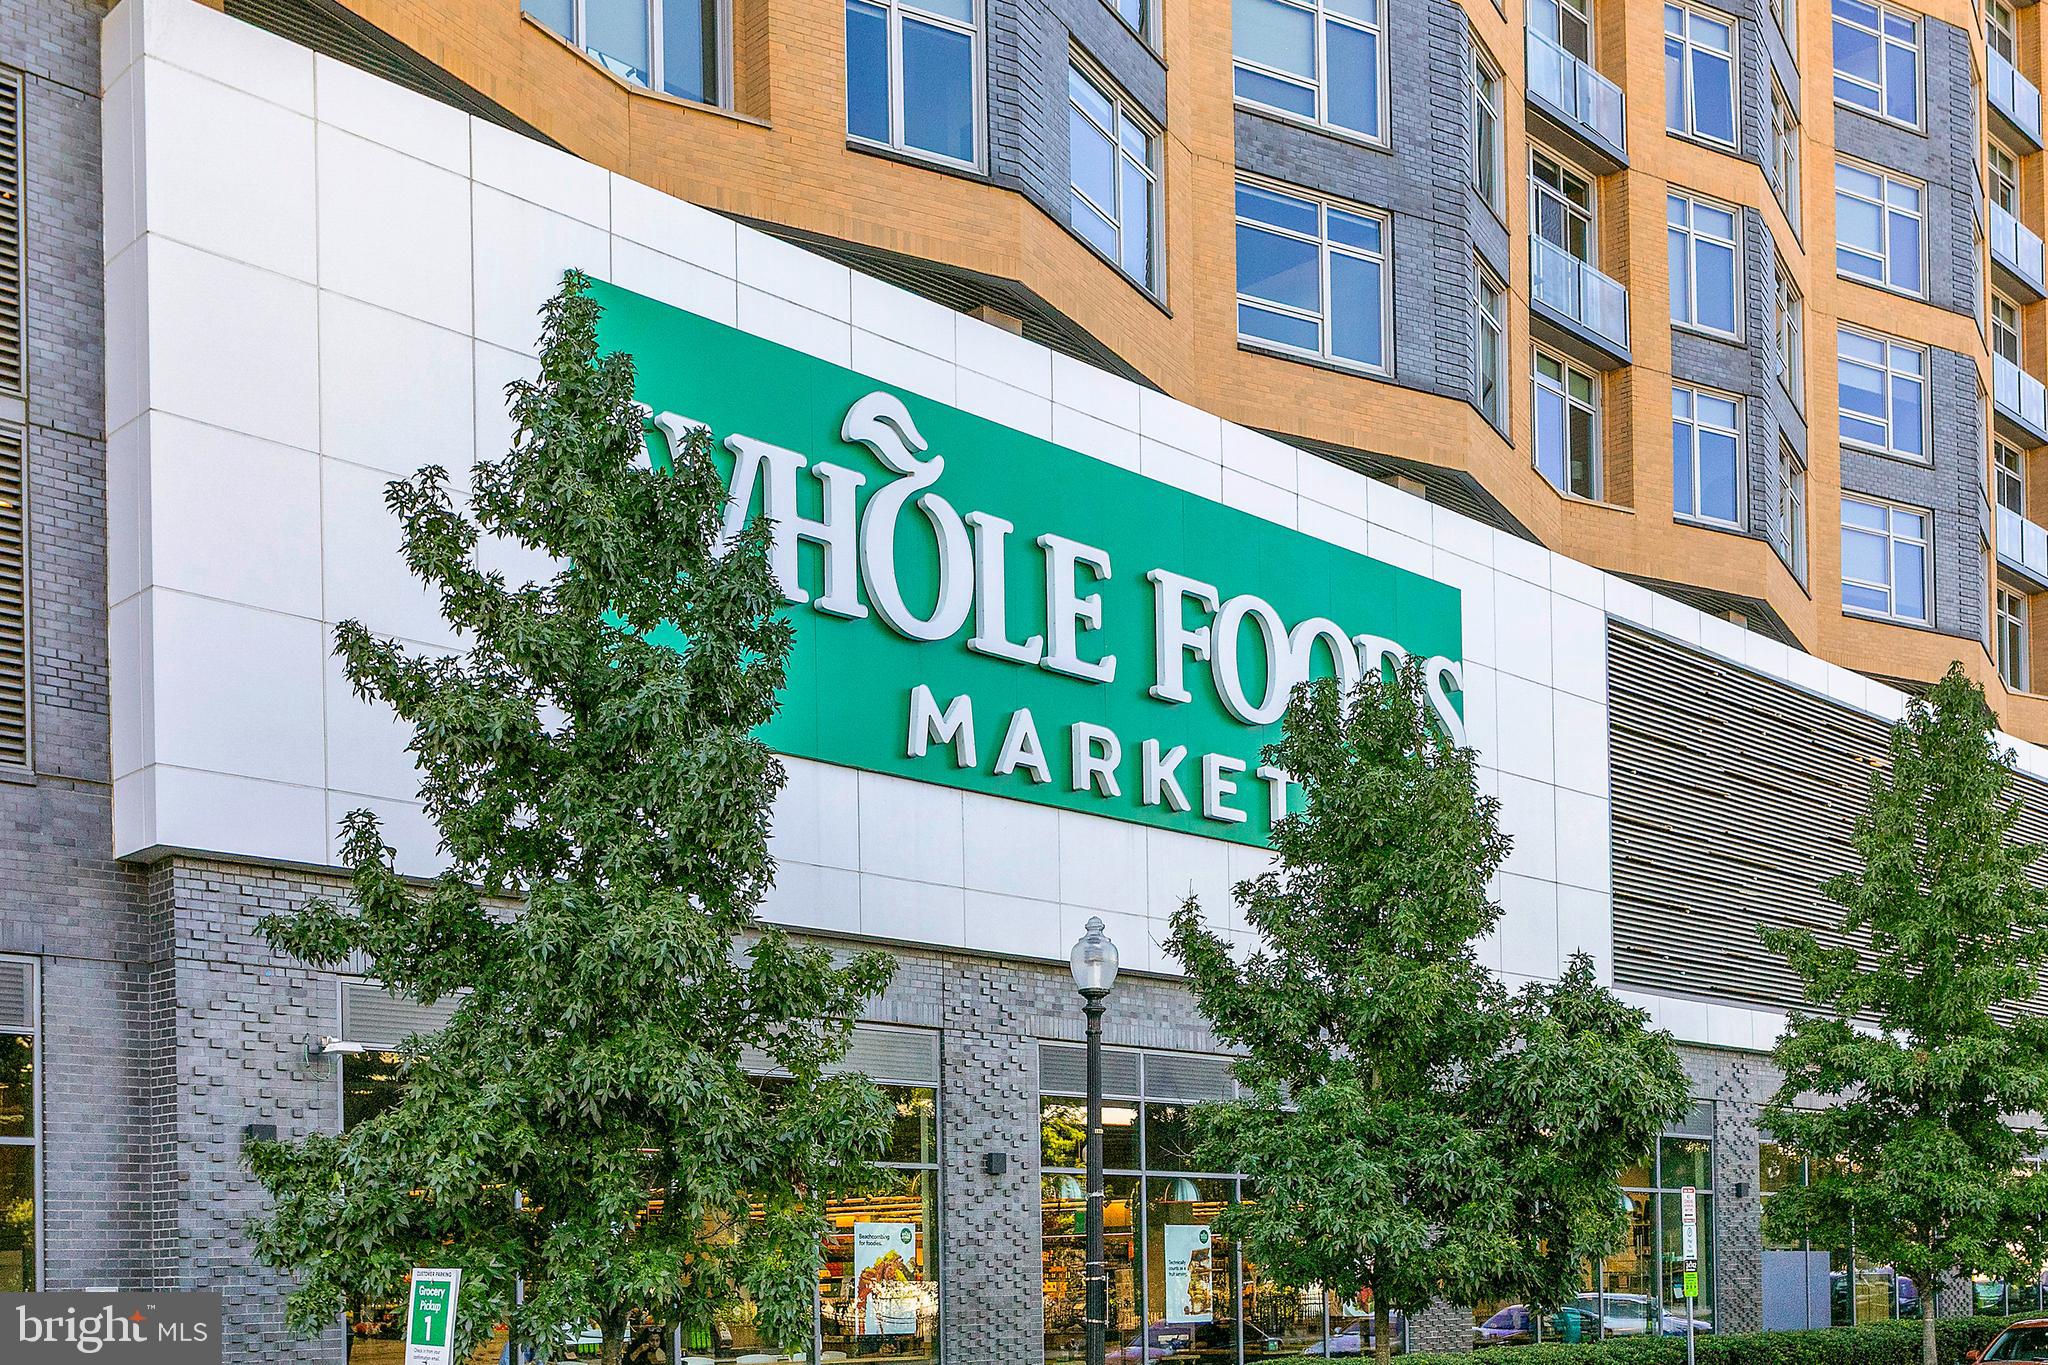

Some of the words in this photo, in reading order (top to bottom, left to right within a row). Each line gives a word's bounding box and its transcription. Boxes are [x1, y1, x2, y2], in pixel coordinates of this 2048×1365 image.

[907, 683, 1300, 832] MARKET
[419, 1285, 446, 1299] Grocery
[420, 1300, 441, 1314] Pickup
[424, 1316, 432, 1341] 1
